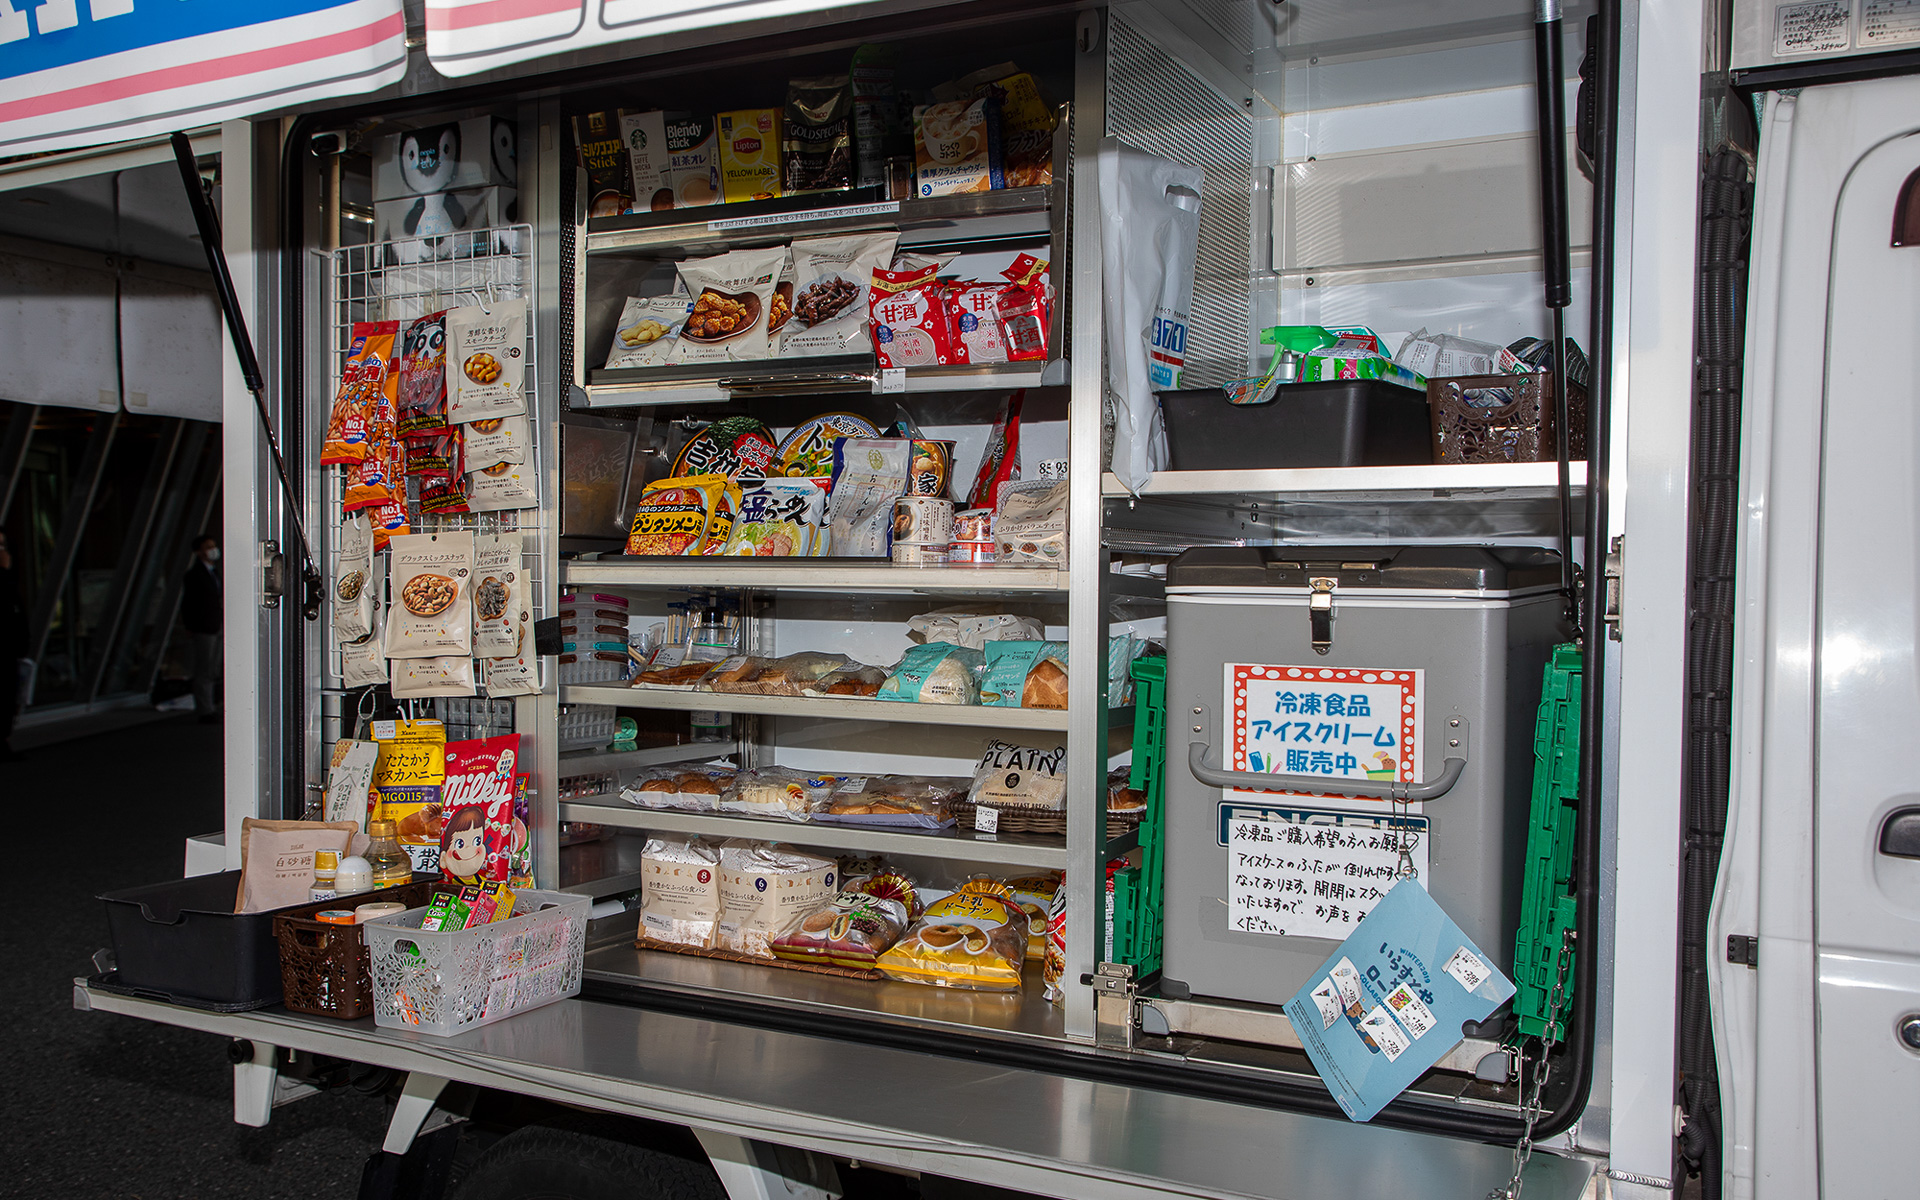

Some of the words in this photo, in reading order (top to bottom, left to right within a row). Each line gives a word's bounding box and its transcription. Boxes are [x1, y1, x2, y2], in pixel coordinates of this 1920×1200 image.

[666, 122, 702, 139] Blendy
[668, 137, 691, 149] stick
[735, 139, 761, 151] Lipton
[671, 154, 707, 168] 紅茶オレ
[939, 150, 961, 159] コトコト
[588, 155, 617, 170] Stick
[725, 168, 753, 178] YELLOW
[753, 167, 776, 177] LABEL
[920, 163, 986, 179] 濃厚クラムチャウダー
[880, 302, 918, 325] 甘酒
[464, 333, 507, 345] スモークチーズ
[1011, 326, 1042, 346] 甘酒
[1151, 316, 1188, 354] #71
[345, 419, 365, 430] No.1
[362, 461, 381, 473] No.1
[1054, 460, 1068, 474] 93
[380, 504, 401, 516] No.1
[631, 516, 697, 534] タンタンメン
[1275, 690, 1371, 717] 冷凍食品
[1251, 719, 1396, 747] アイスクリーム
[385, 752, 430, 767] たたかう
[979, 749, 1057, 777] PLAIN
[1286, 748, 1357, 775] 販売中
[376, 768, 444, 783] マヌカハニー
[442, 770, 513, 819] Milky
[275, 855, 312, 868] 白砂糖
[957, 893, 983, 908] 牛乳
[1237, 915, 1286, 936] ください。
[1400, 947, 1431, 984] WINTER2019
